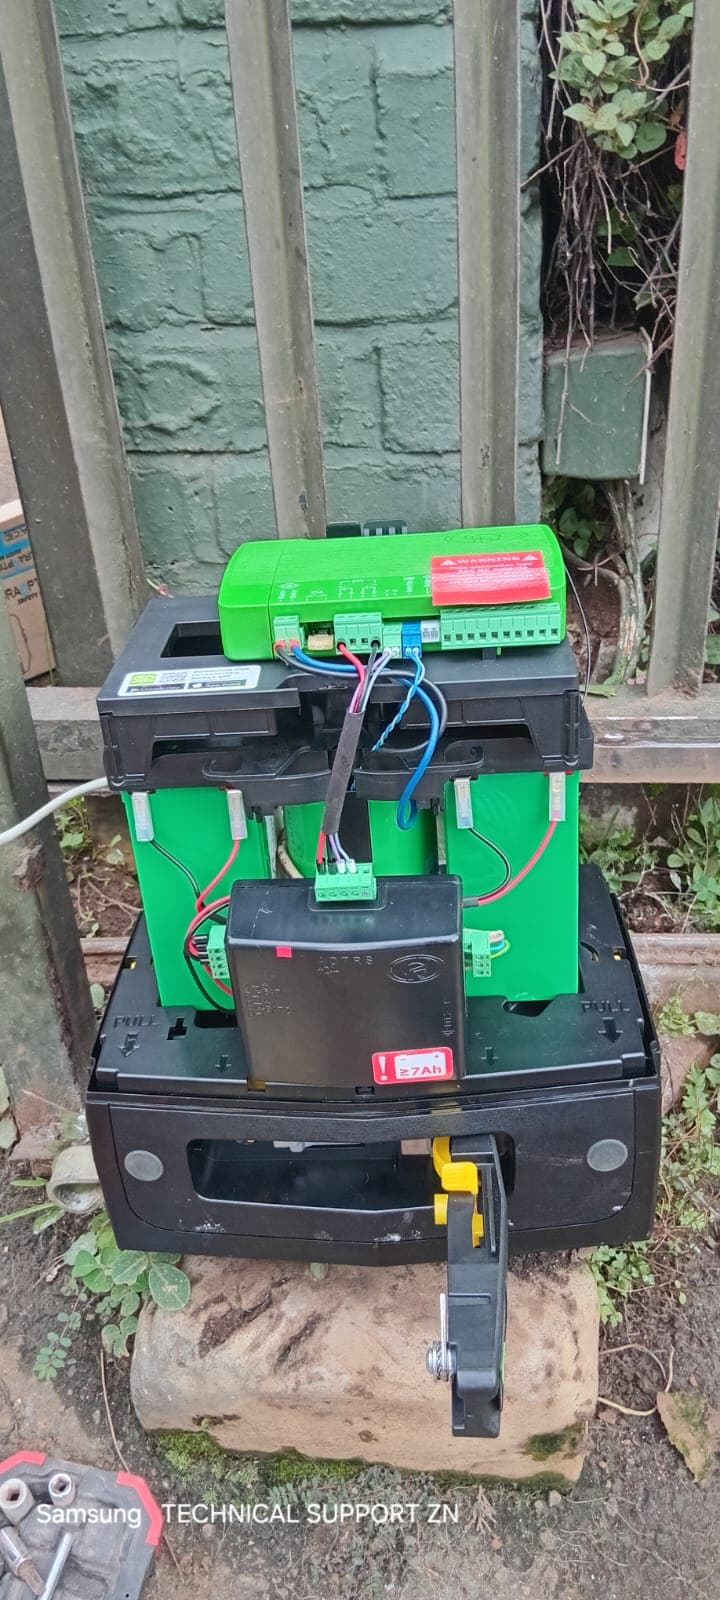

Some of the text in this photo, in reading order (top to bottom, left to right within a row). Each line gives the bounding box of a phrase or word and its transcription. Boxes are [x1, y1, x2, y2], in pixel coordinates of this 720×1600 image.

[457, 555, 520, 565] WARNING
[580, 999, 631, 1013] PULL
[113, 1014, 160, 1028] PULL
